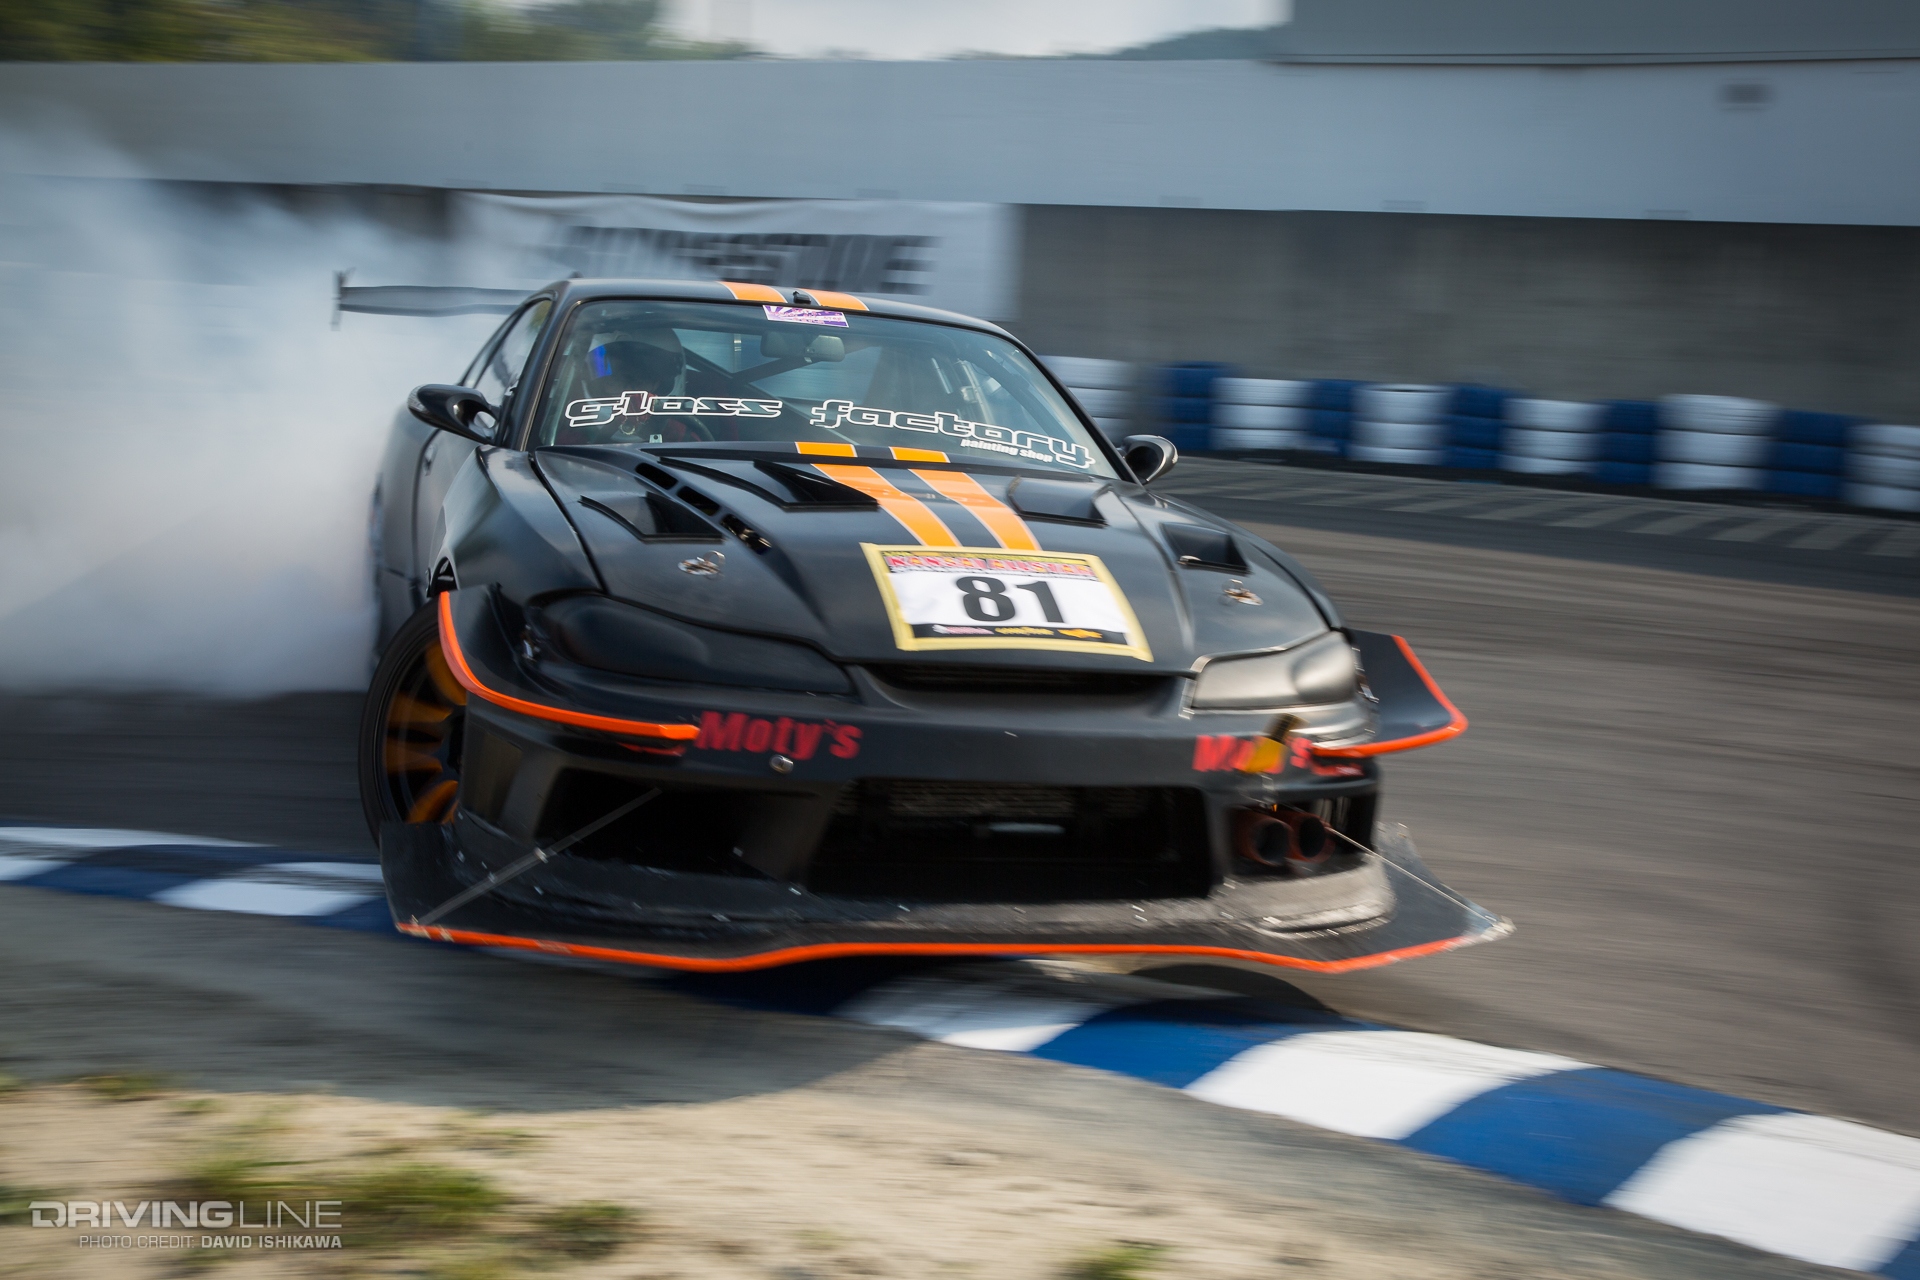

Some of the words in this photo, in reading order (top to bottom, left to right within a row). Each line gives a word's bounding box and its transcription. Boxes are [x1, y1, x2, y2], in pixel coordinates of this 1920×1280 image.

[809, 398, 1096, 469] factory
[960, 437, 1018, 457] painting
[1019, 448, 1053, 464] shop
[955, 576, 1066, 624] 81
[692, 710, 864, 760] Moty's
